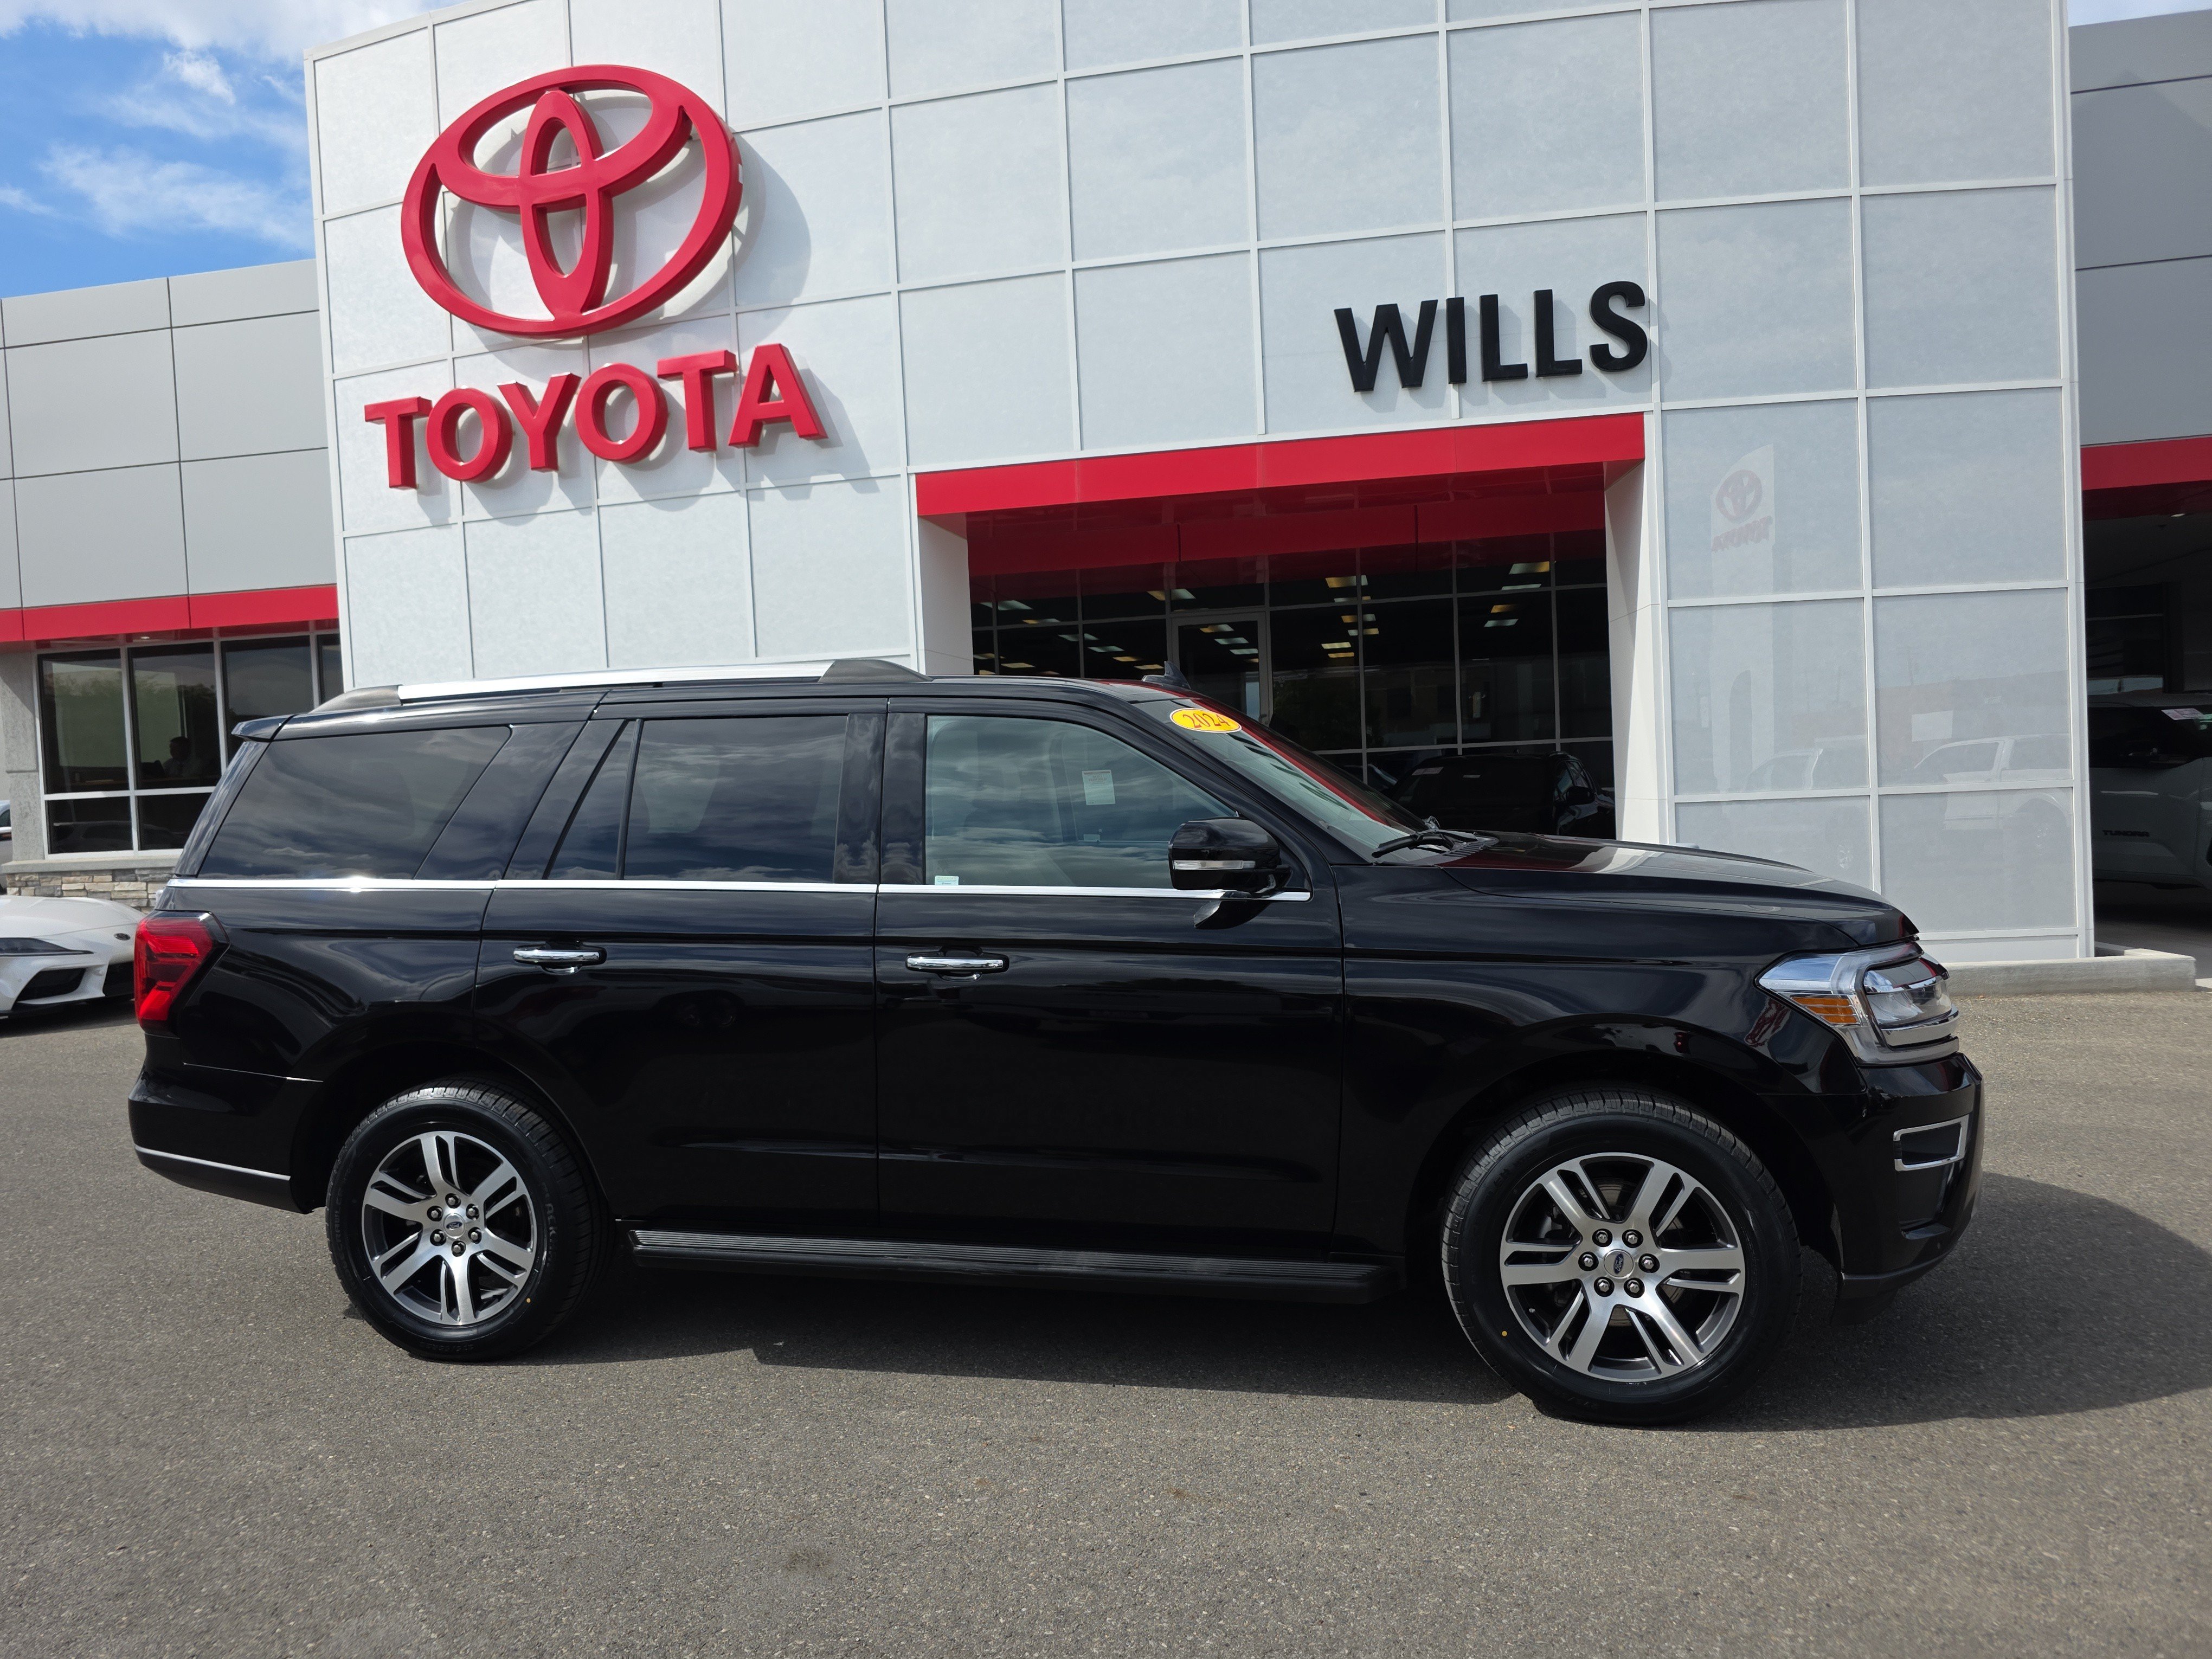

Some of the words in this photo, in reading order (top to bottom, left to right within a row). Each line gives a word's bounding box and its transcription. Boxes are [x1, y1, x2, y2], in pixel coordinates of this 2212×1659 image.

[1334, 281, 1648, 393] WILLS
[364, 343, 829, 490] TOYOTA
[1182, 713, 1231, 728] 2024
[1614, 1256, 1623, 1272] Ford
